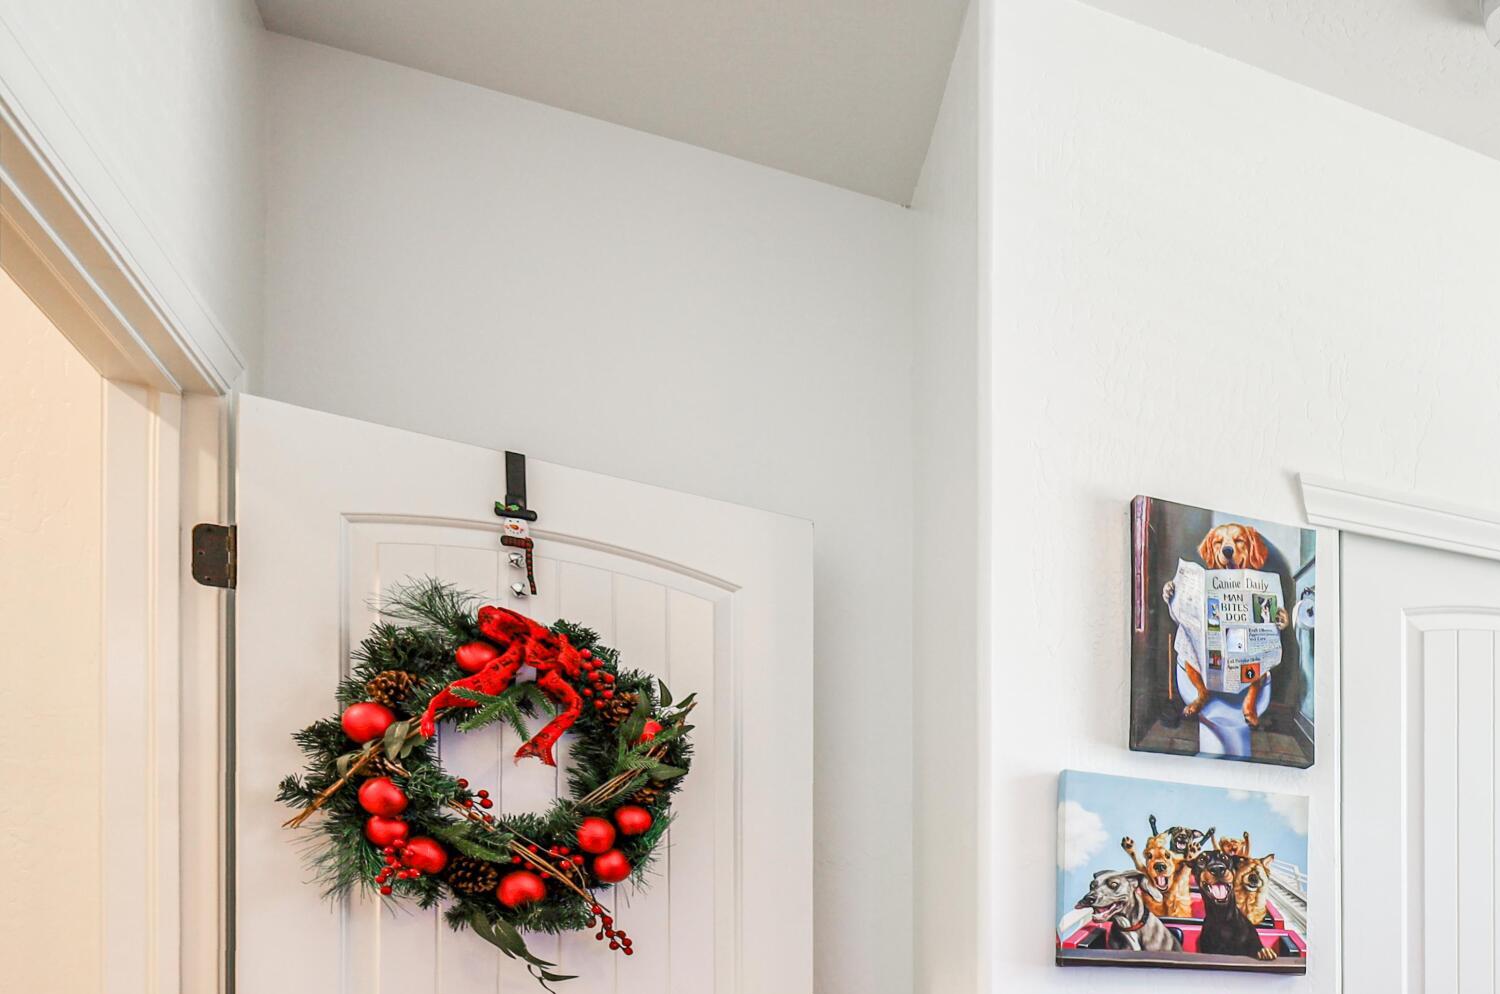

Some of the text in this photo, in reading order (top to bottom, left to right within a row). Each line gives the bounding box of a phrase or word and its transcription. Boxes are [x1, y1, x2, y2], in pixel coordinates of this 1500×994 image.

[1212, 576, 1269, 592] Canine Daily
[1223, 593, 1244, 602] MAN
[1221, 602, 1249, 612] BITES
[1225, 612, 1247, 622] DOG
